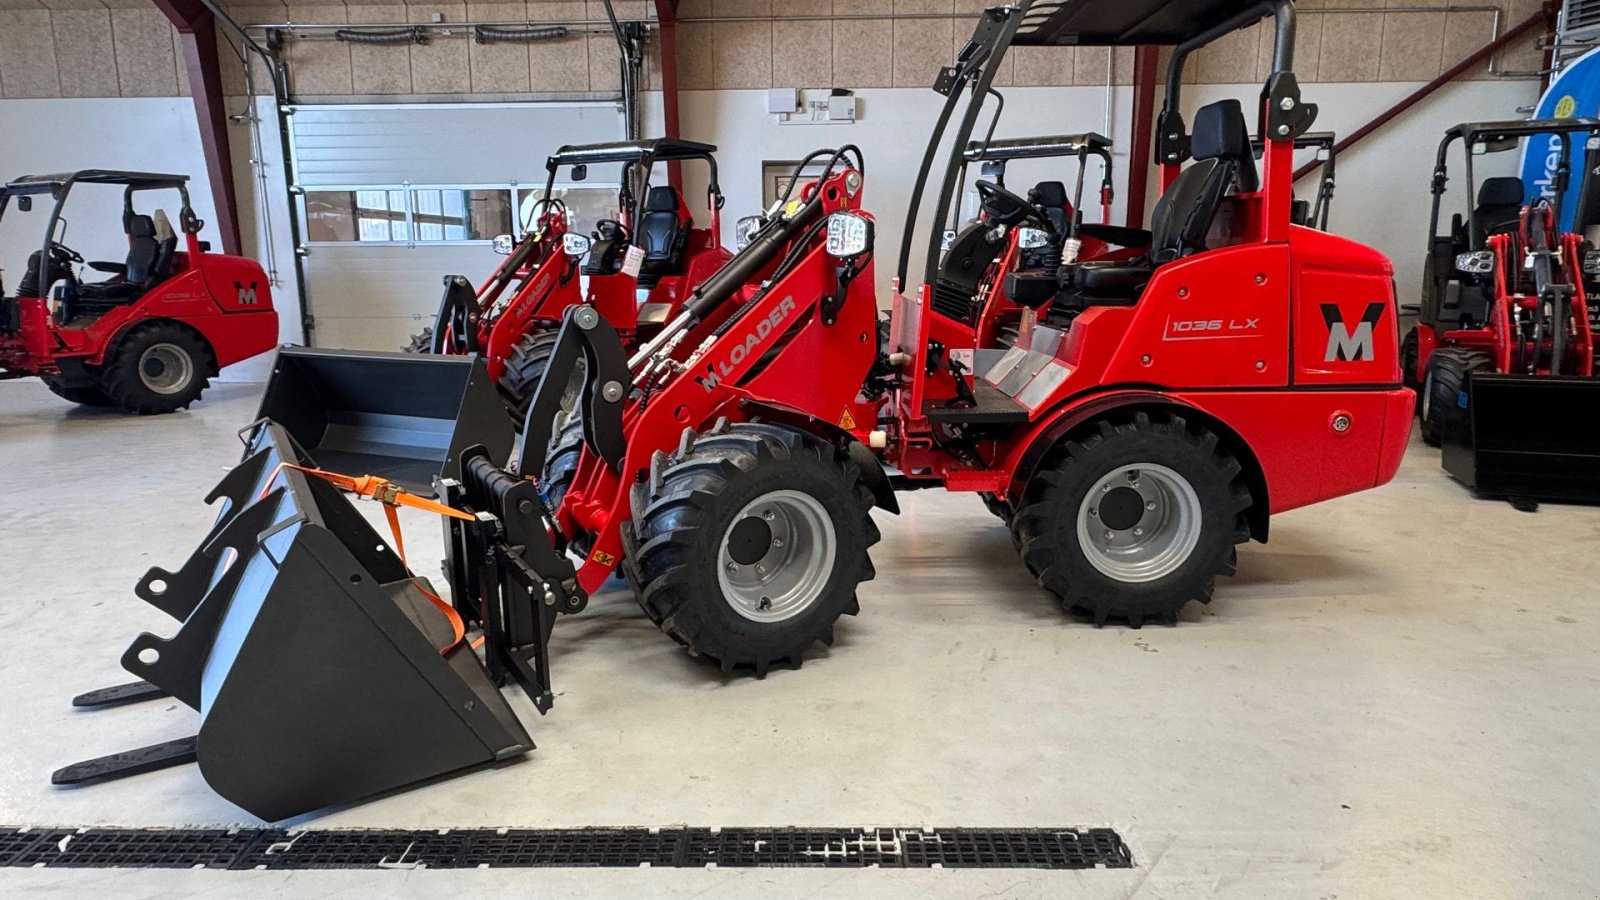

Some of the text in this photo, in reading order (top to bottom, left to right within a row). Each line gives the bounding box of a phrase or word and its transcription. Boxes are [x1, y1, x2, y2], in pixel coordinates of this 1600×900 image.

[719, 294, 796, 376] LOADER
[1171, 318, 1260, 332] 1036 LX
